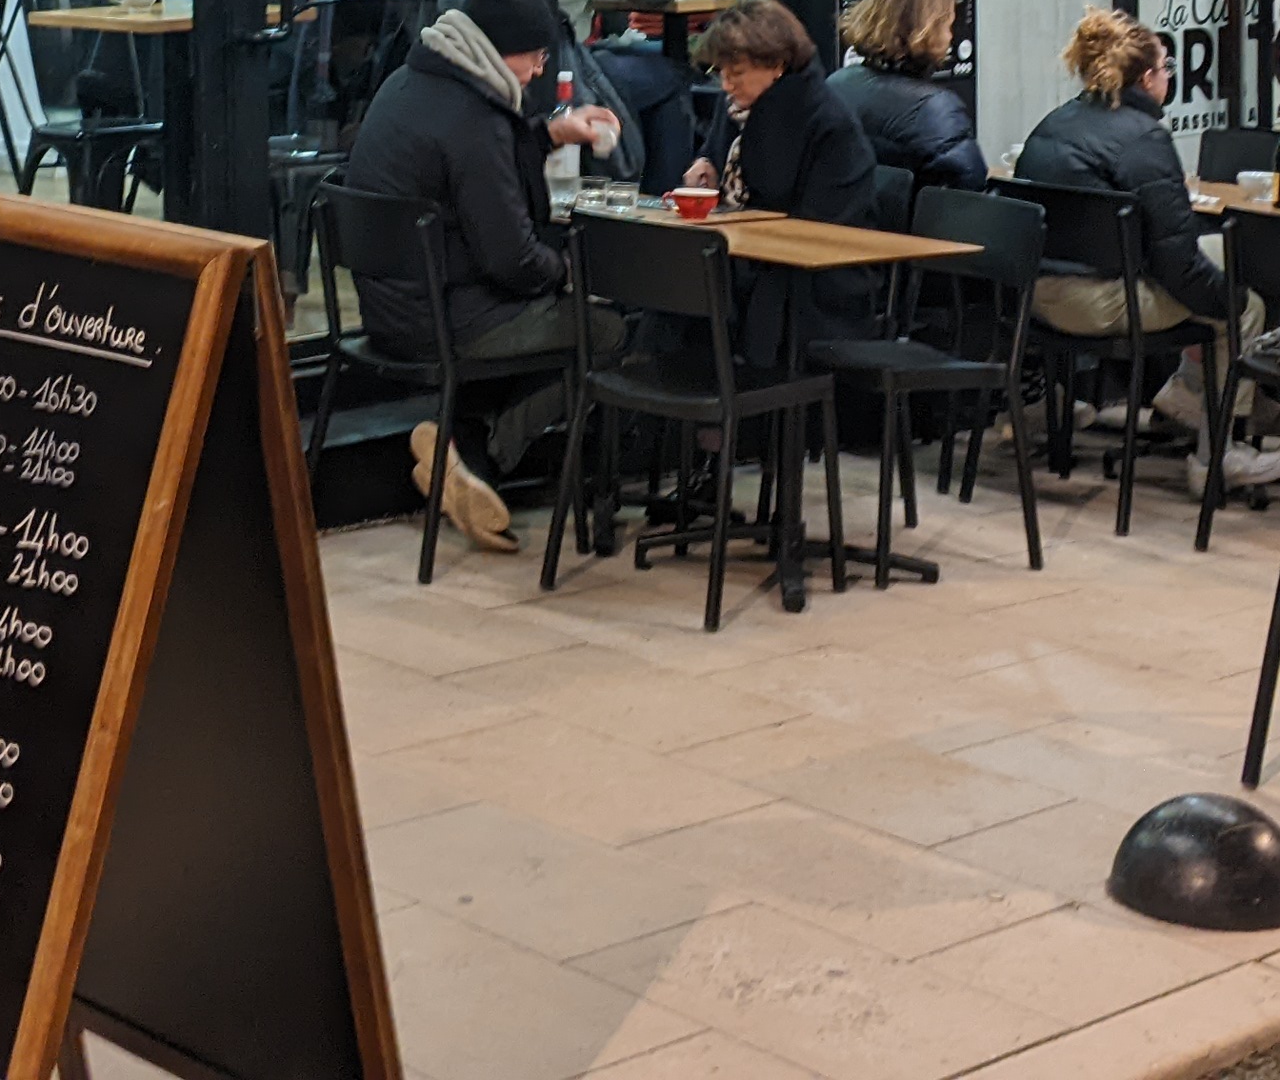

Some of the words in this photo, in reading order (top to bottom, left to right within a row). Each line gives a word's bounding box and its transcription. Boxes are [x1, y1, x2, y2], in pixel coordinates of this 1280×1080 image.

[32, 373, 99, 417] 16h30
[22, 426, 80, 464] 14h00
[20, 456, 75, 488] 21h00
[12, 507, 90, 560] 14h00
[6, 552, 79, 596] 21h00
